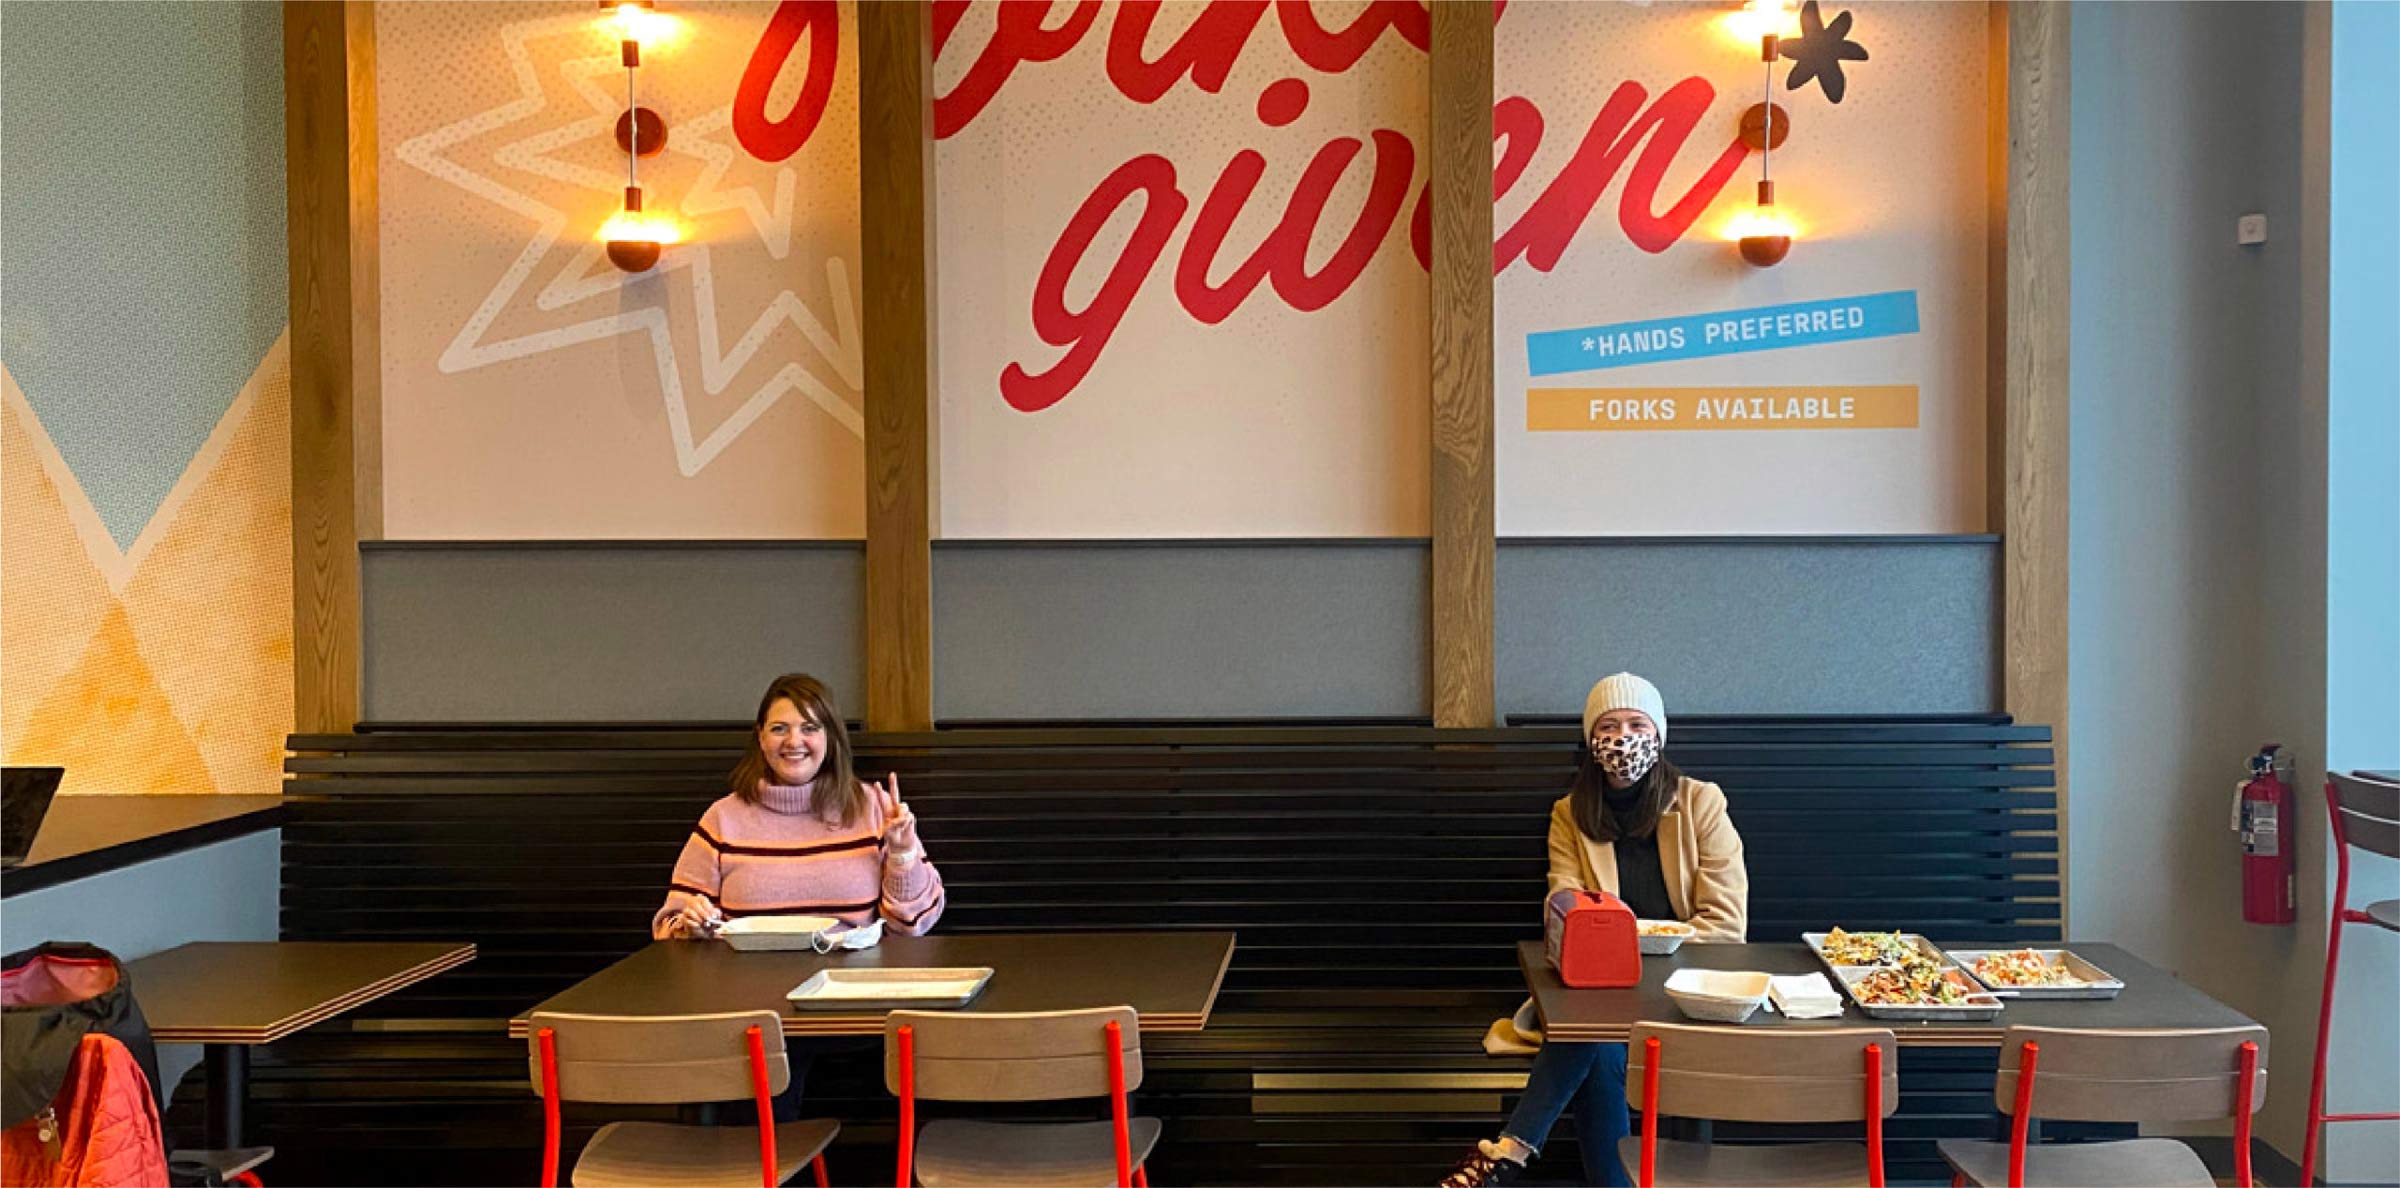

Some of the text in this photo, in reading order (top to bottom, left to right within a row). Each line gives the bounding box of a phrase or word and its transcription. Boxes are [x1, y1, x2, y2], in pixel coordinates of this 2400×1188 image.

[1705, 307, 1864, 344] PREFERRED
[1589, 397, 1855, 421] FORKS AVAILABLE
